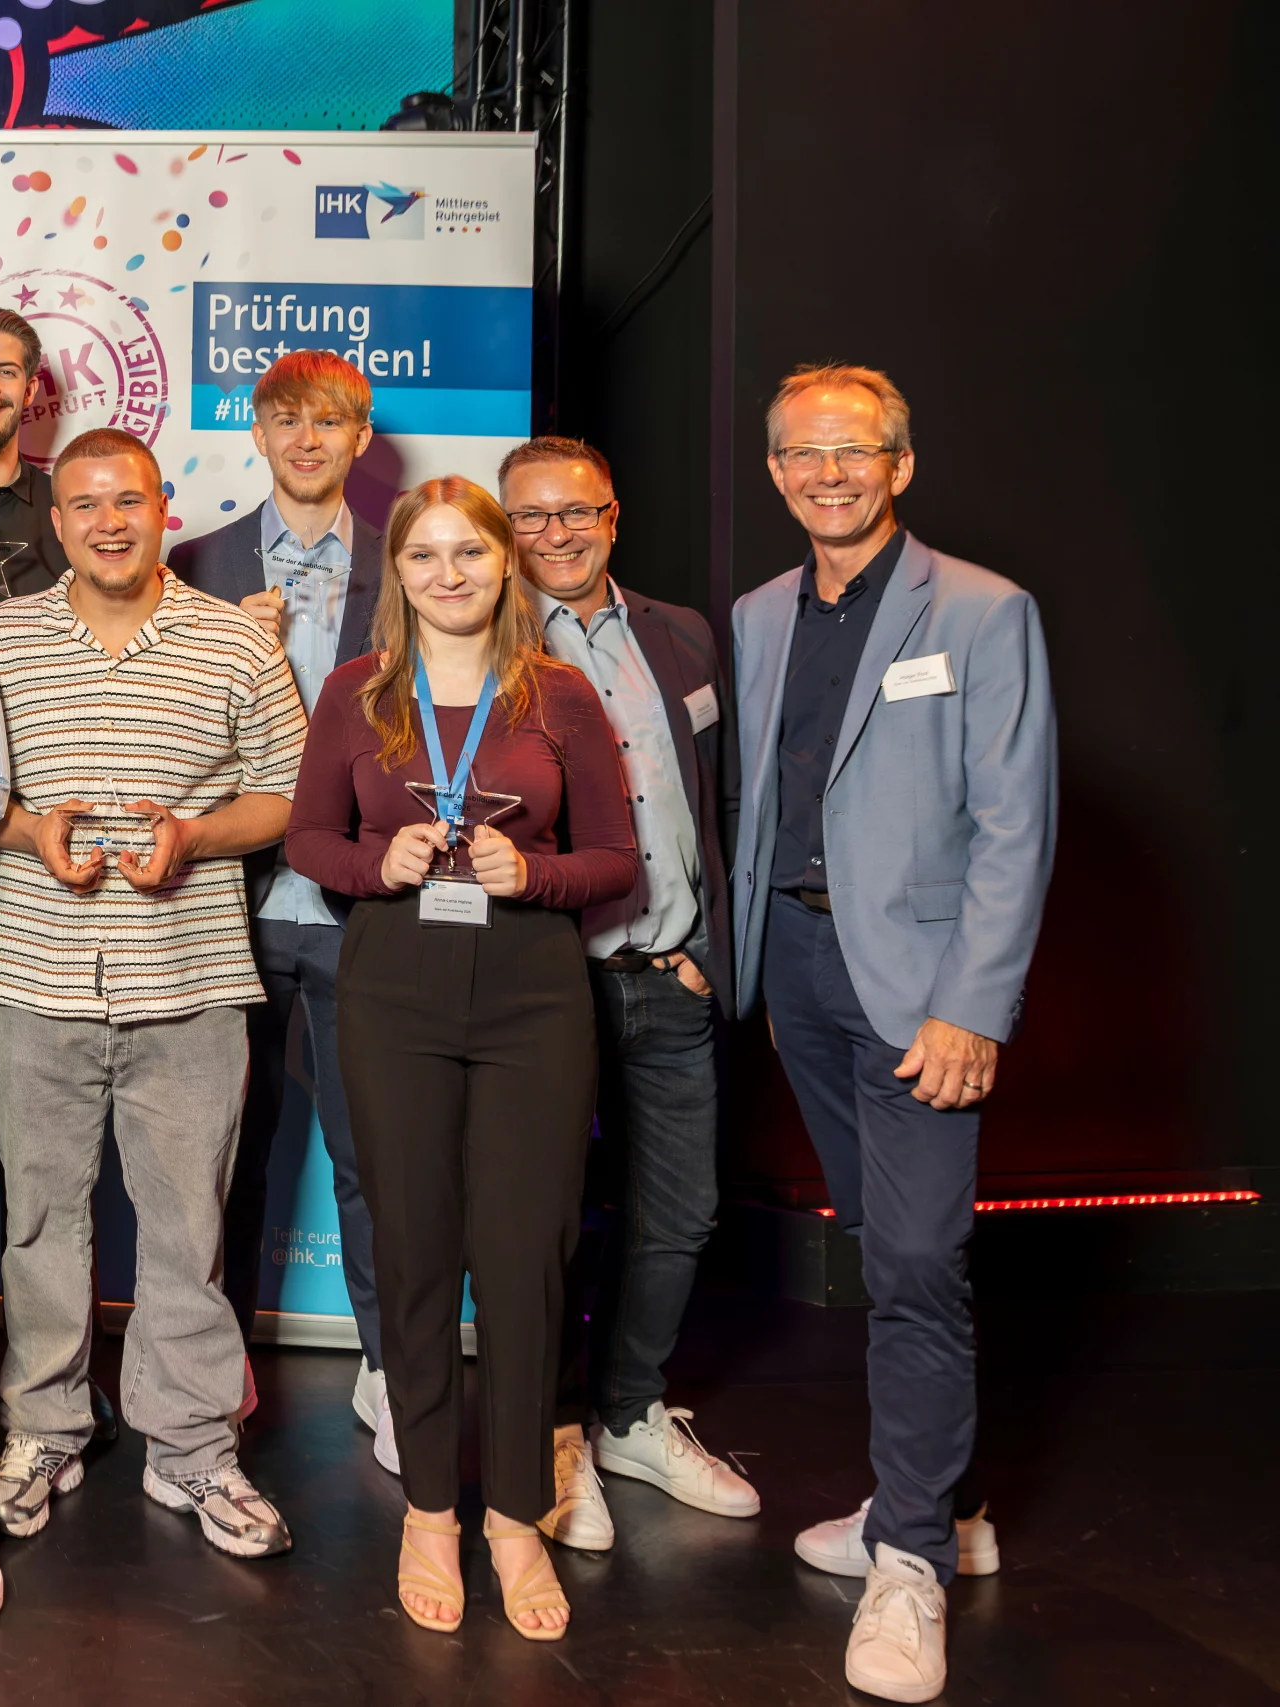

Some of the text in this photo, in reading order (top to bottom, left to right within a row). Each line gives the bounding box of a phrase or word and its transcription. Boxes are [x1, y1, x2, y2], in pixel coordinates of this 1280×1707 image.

[319, 192, 363, 214] IHK
[435, 197, 489, 210] Mittleres
[435, 210, 501, 224] Ruhrgebiet
[208, 293, 371, 342] Prüfung
[208, 336, 432, 378] bestden!
[297, 561, 333, 573] Ausbildung
[443, 791, 456, 799] der
[453, 803, 471, 811] 2026
[271, 1226, 304, 1244] Teilt
